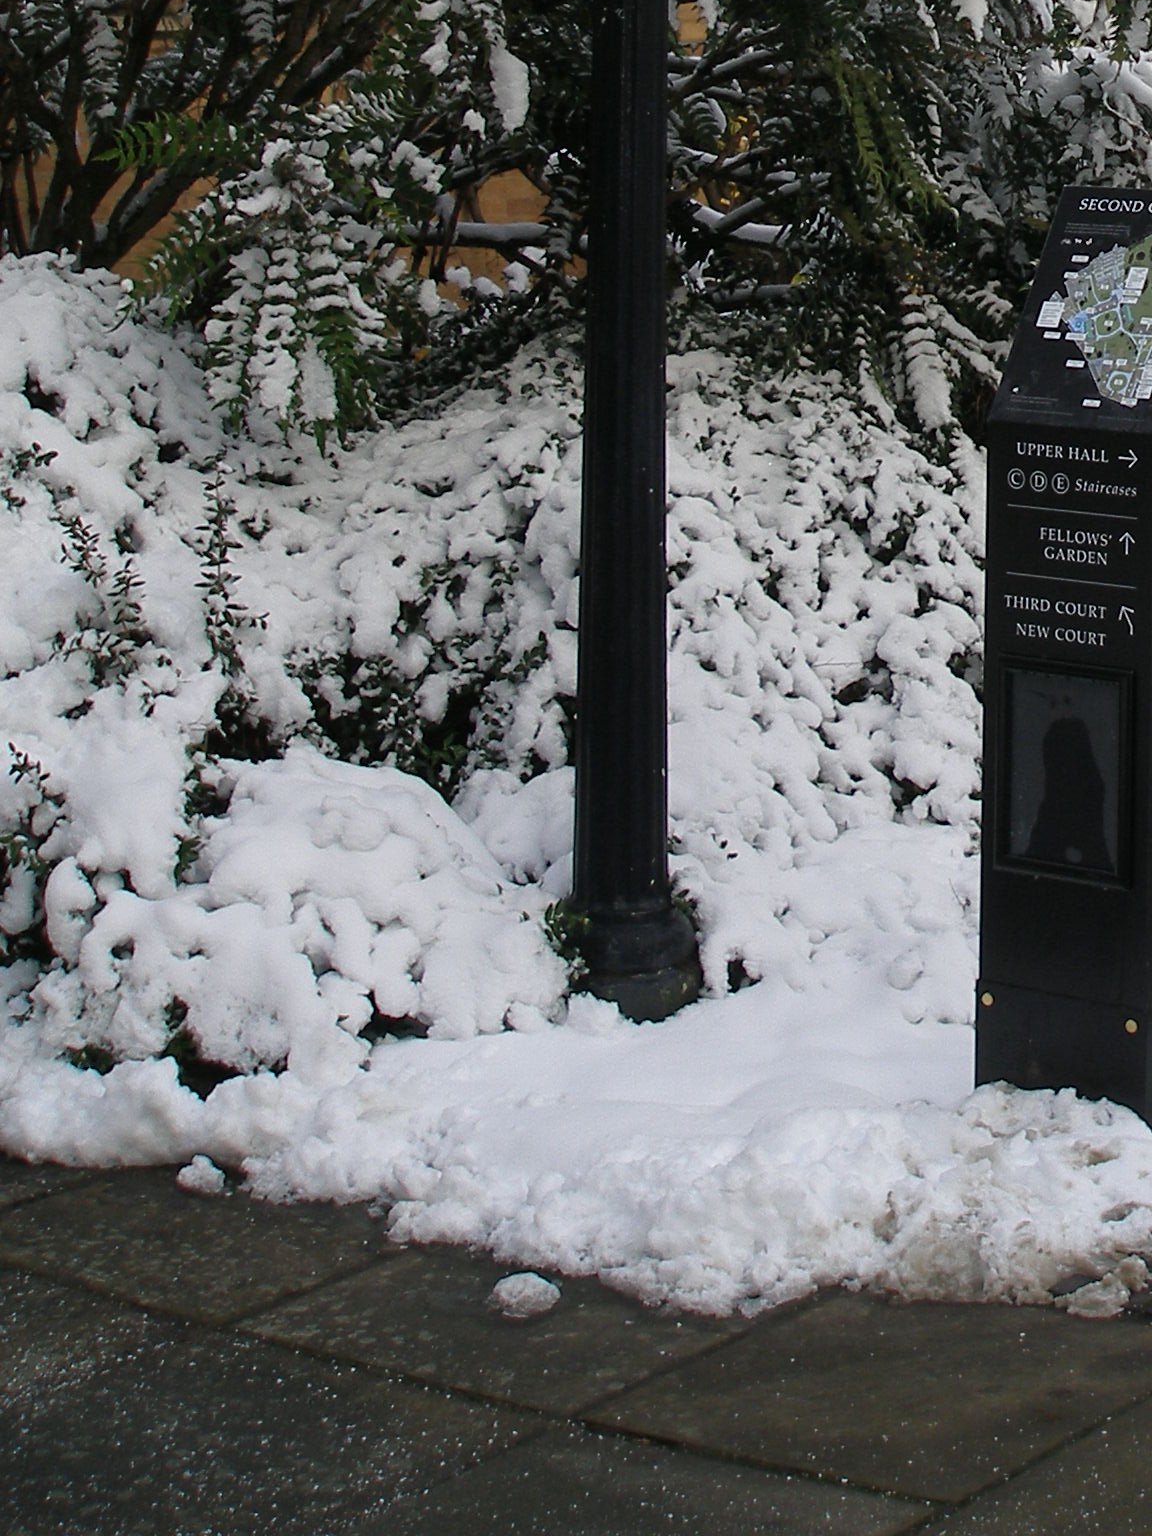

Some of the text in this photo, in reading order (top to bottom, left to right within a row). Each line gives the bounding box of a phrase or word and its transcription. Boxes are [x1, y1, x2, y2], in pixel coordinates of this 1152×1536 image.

[1079, 198, 1144, 213] SECOND
[1016, 442, 1109, 463] UPPER HALL
[1008, 469, 1137, 496] C D E Staircases
[1044, 547, 1108, 566] GARDEN
[1004, 594, 1107, 619] THIRD COURT
[1016, 623, 1106, 646] NEW COURT
